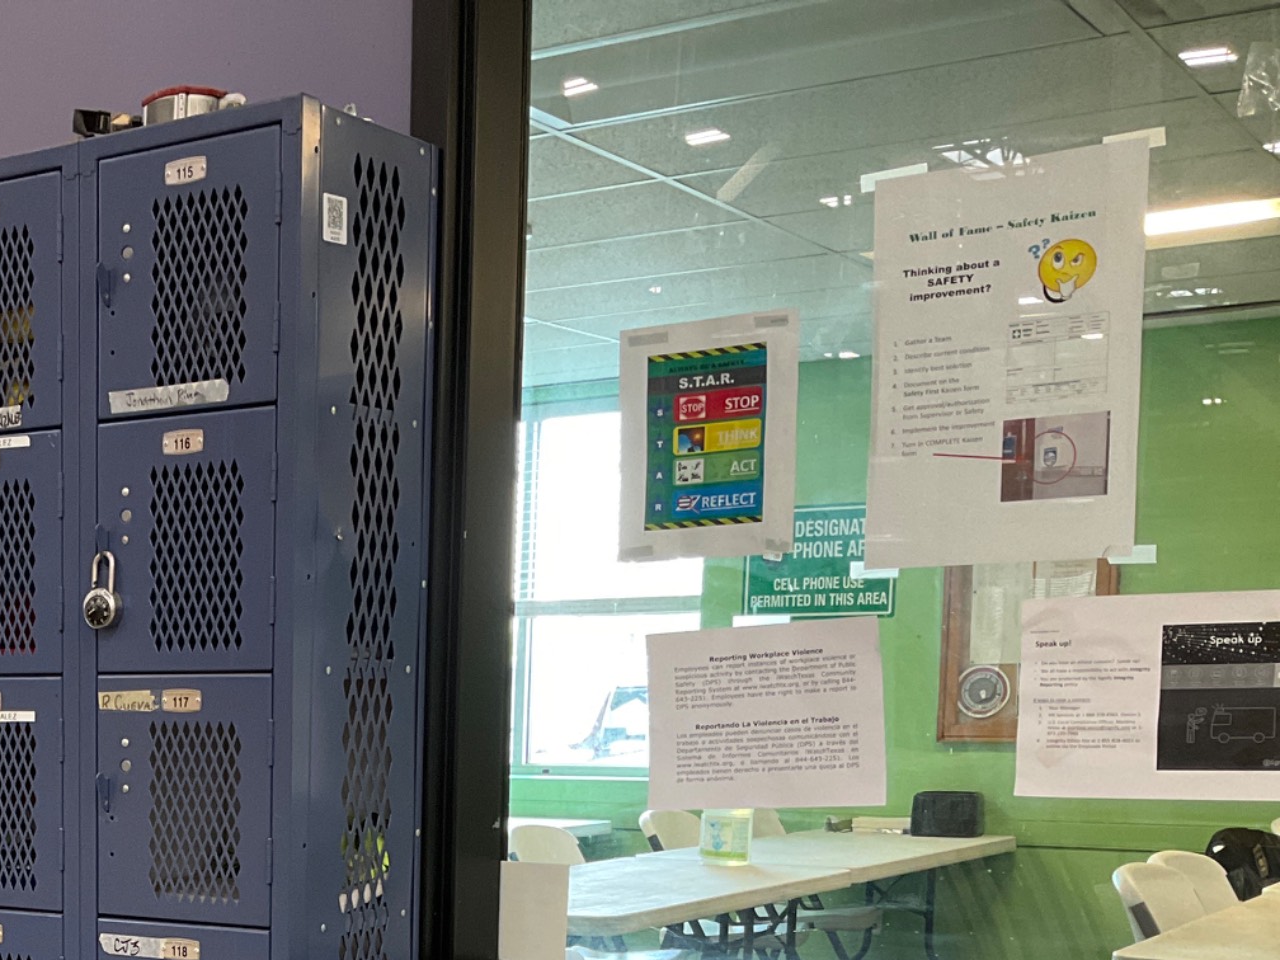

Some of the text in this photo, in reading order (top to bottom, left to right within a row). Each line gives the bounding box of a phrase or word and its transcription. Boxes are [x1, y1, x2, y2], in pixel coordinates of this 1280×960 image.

[176, 166, 193, 180] 115
[909, 231, 937, 243] Wall
[941, 228, 954, 239] of
[959, 224, 993, 236] Fame
[1007, 215, 1046, 229] Safety
[1050, 209, 1097, 223] Kaizen
[903, 260, 1001, 278] Thinking about a
[927, 274, 975, 288] SAFETY
[909, 284, 992, 302] improvement?
[679, 372, 735, 389] S.T.A.R.
[681, 401, 705, 414] STOP
[725, 394, 760, 410] STOP
[657, 409, 663, 417] S
[717, 428, 758, 444] THINK
[925, 437, 961, 447] COMPLETE
[174, 437, 191, 450] 116
[657, 440, 663, 449] T
[730, 459, 757, 473] ACT
[656, 472, 663, 480] A
[655, 503, 662, 511] R
[701, 492, 756, 509] REFLECT
[795, 518, 866, 538] DESIGNAT
[793, 540, 844, 559] PHONE
[773, 575, 864, 592] CELL PHONE USE
[750, 592, 887, 608] PERMITTED IN THIS AREA
[1035, 639, 1072, 648] Speak up!
[1210, 634, 1262, 647] Speak up
[709, 648, 824, 662] Reporting Workplace Violence
[102, 694, 110, 708] R
[173, 697, 189, 708] 117
[695, 722, 740, 730] Reportando
[752, 719, 788, 727] Violencia
[810, 716, 840, 724] Trabajo
[171, 945, 188, 957] 118
